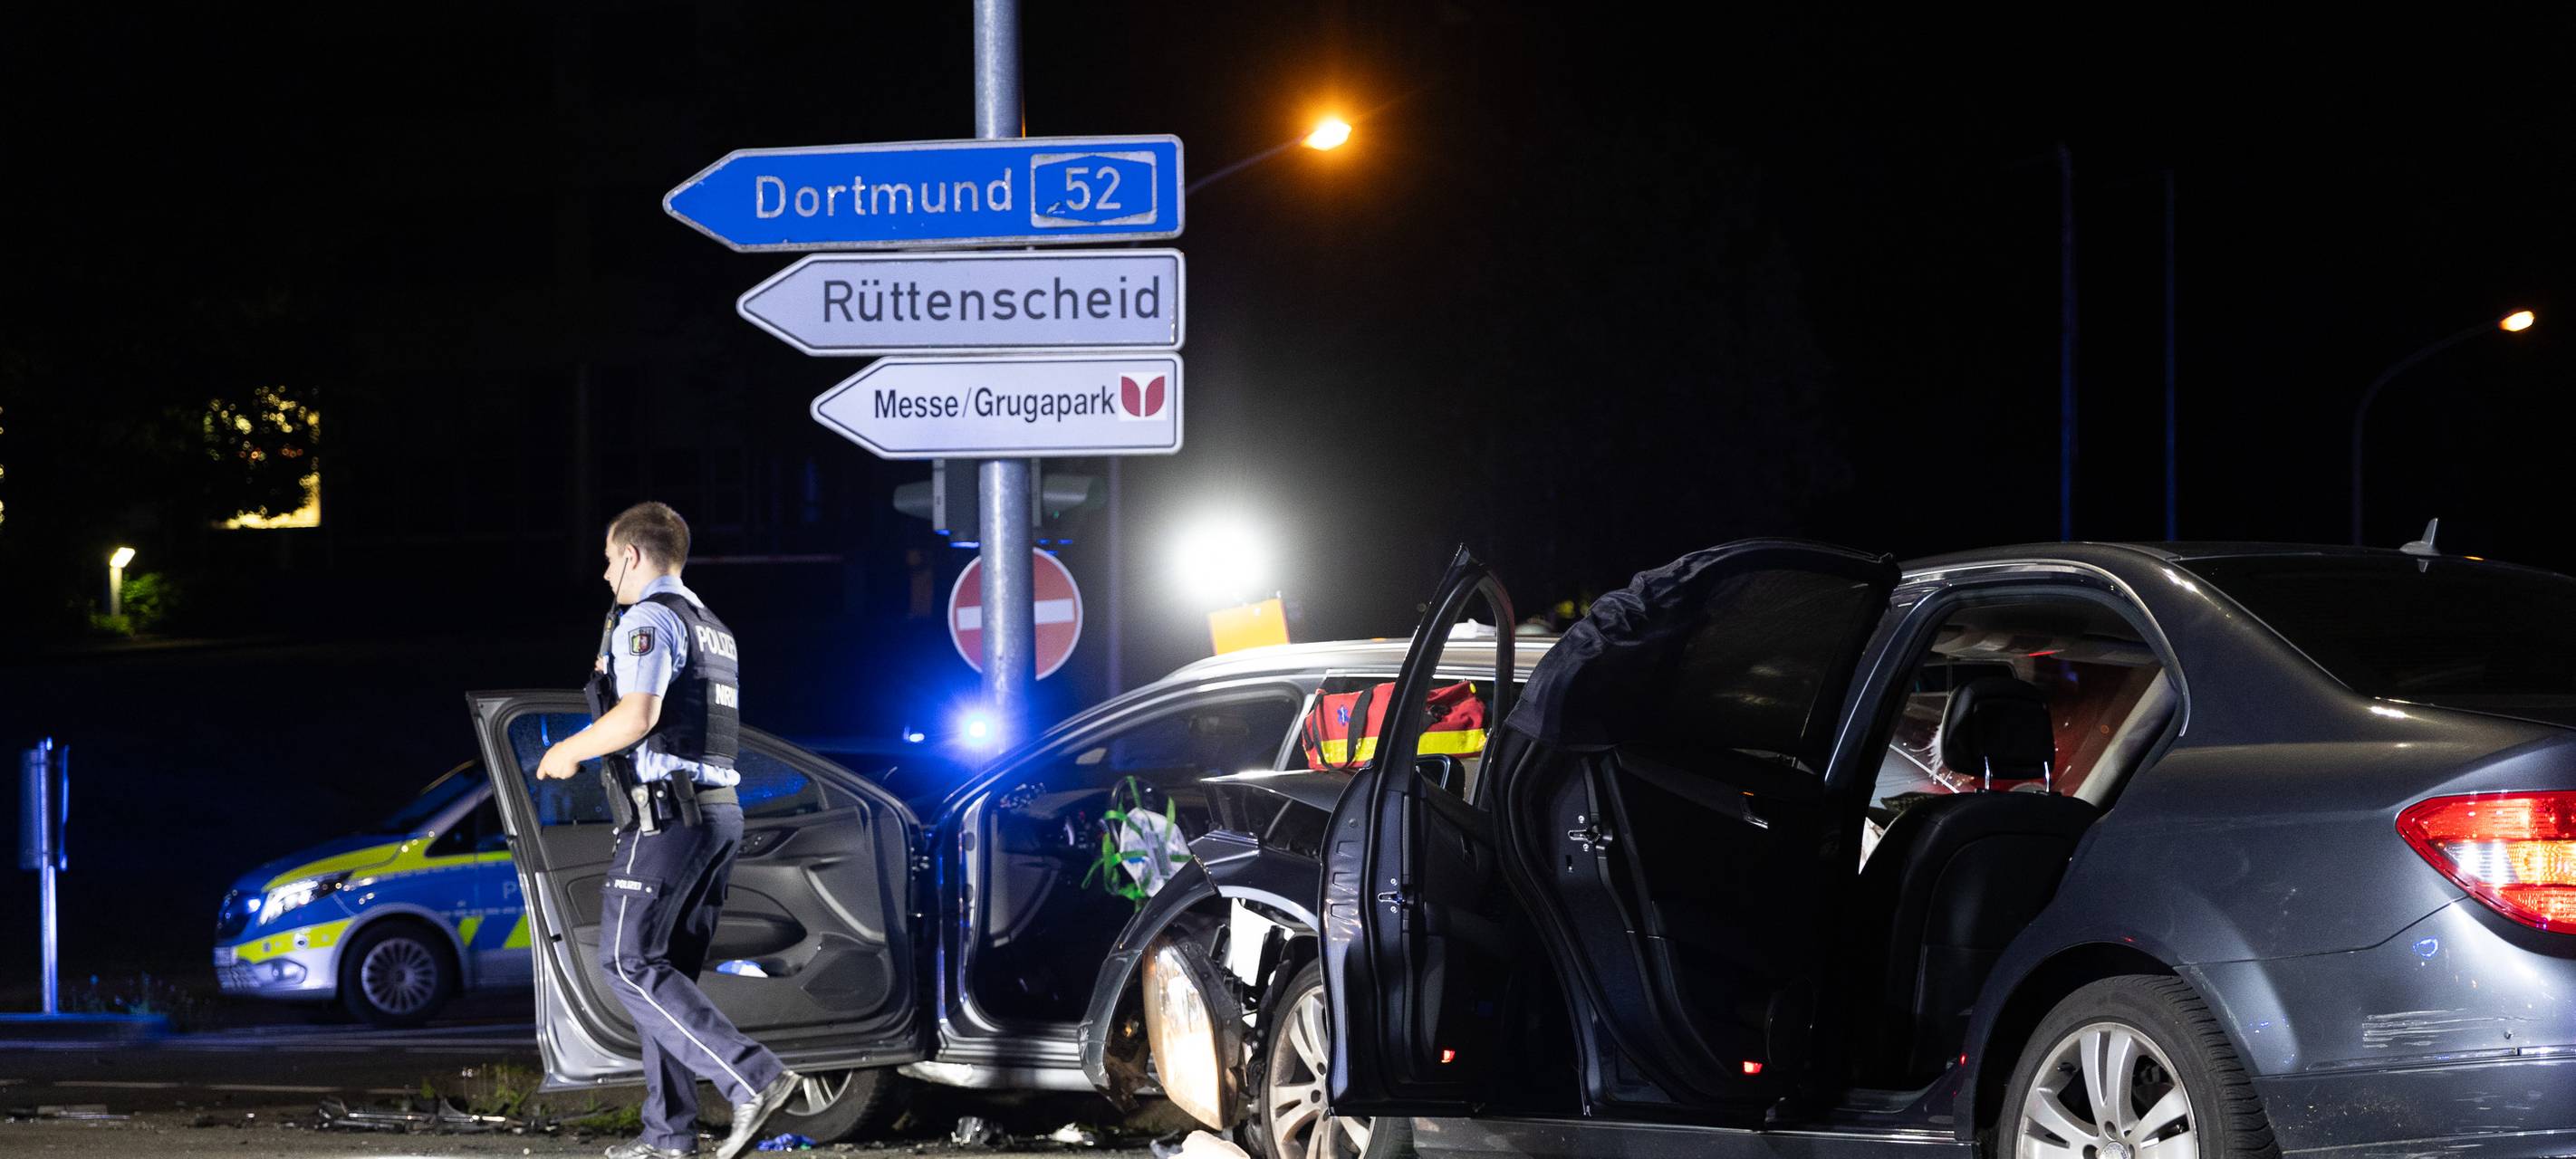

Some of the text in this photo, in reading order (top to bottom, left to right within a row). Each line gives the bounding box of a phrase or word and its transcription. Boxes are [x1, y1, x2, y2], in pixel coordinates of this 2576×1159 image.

[755, 166, 1122, 219] Dortmund 52
[822, 275, 1160, 322] Rüttenscheid
